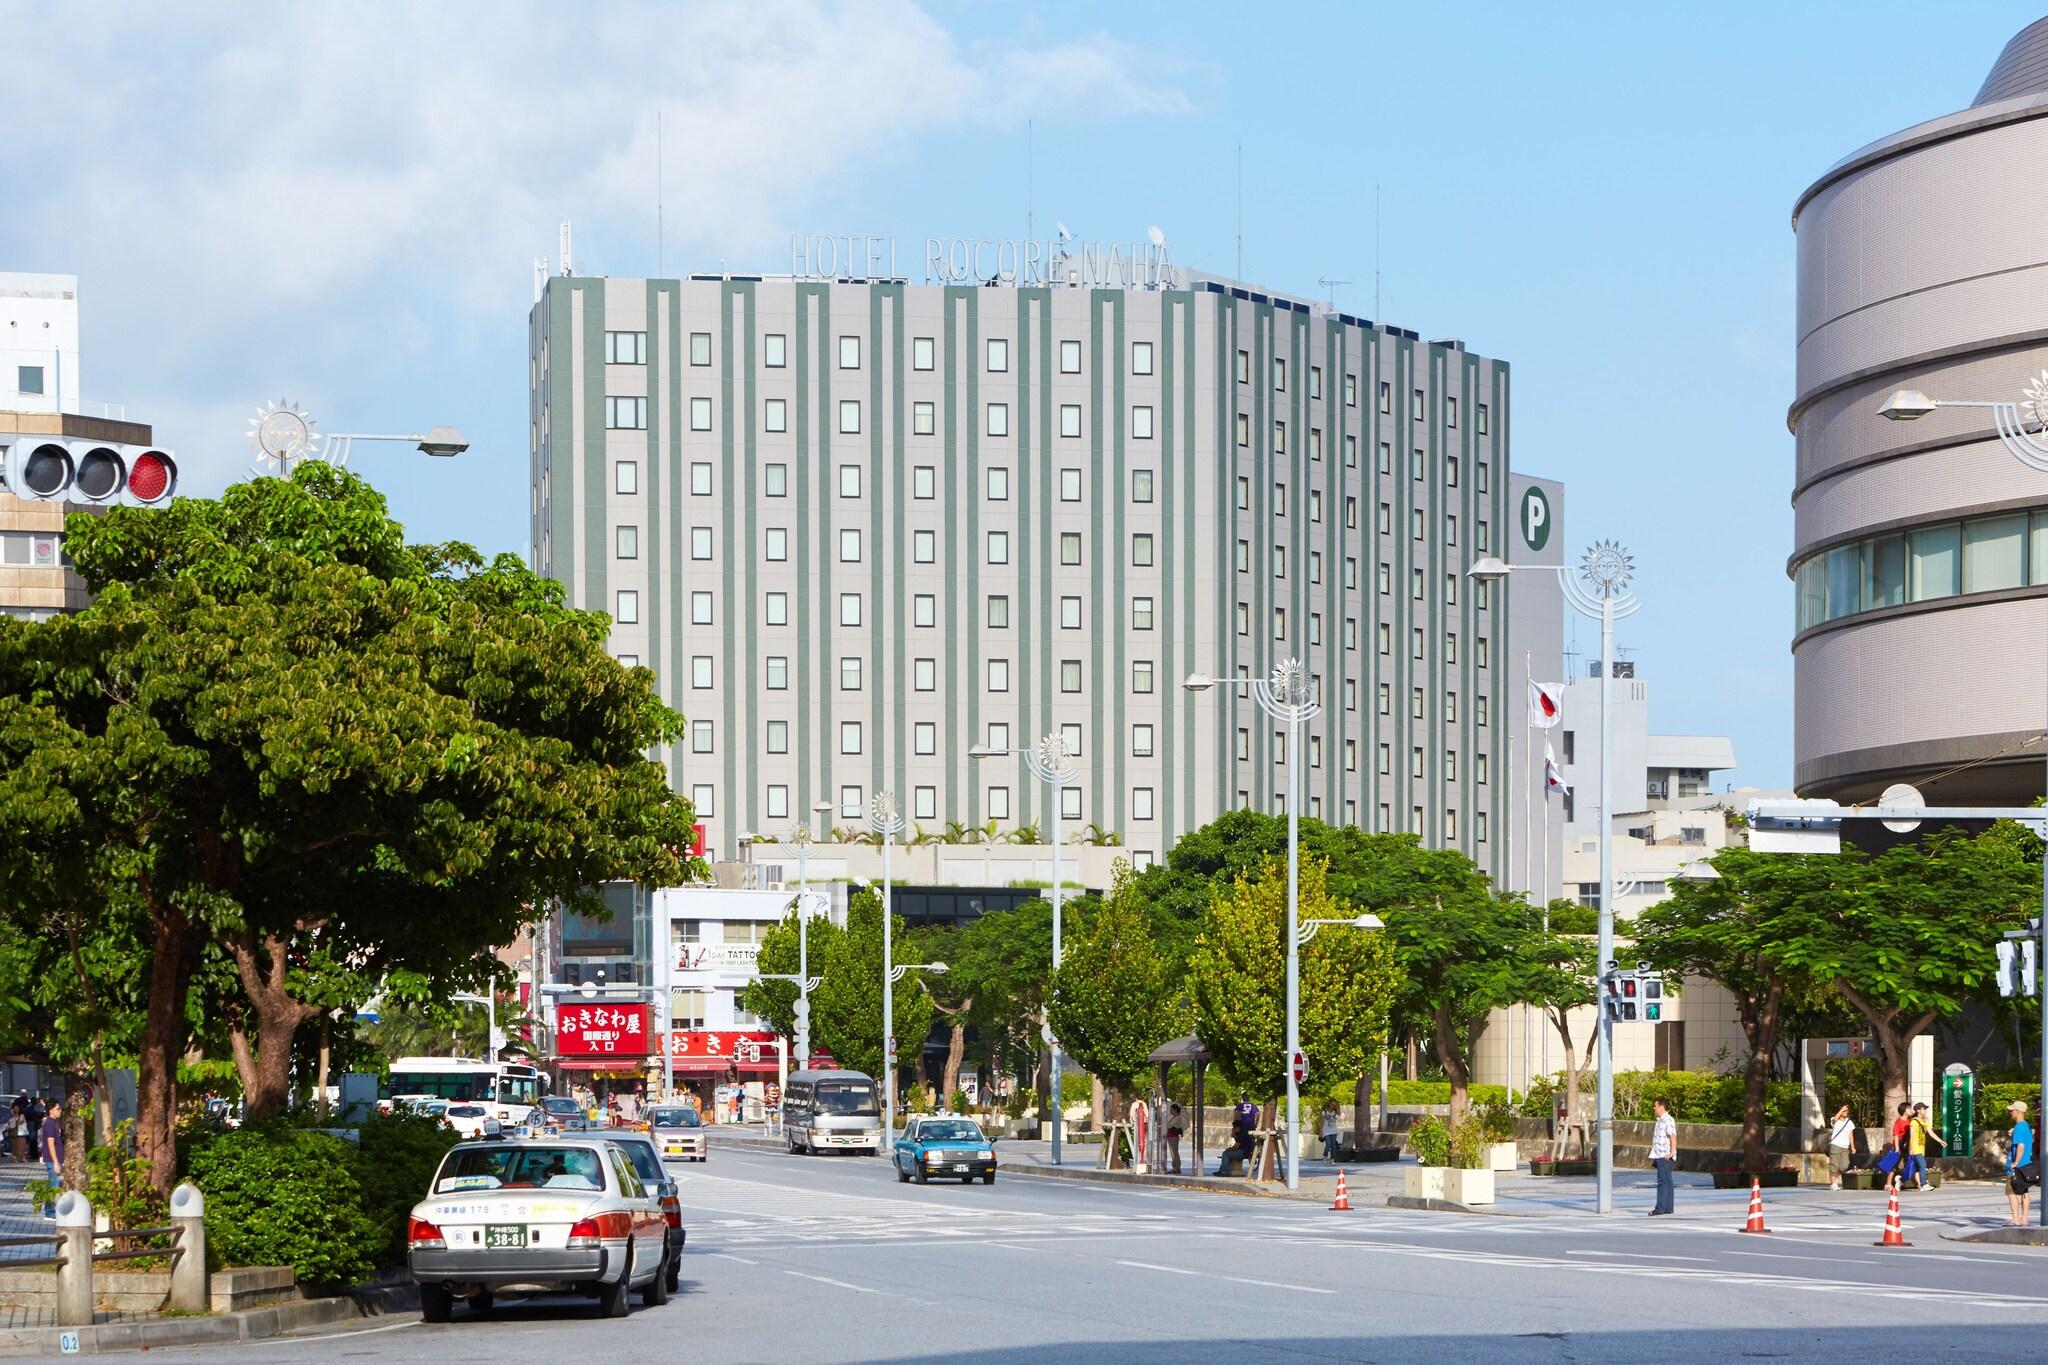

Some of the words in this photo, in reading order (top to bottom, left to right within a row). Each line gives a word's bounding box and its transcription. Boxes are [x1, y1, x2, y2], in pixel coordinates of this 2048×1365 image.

[791, 234, 906, 279] HOTEL
[925, 238, 1066, 284] ROCORE
[1082, 240, 1176, 285] NAHA
[1527, 495, 1546, 542] P
[560, 1007, 642, 1035] おきなわ屋
[588, 1040, 615, 1052] 入口
[470, 1205, 490, 1214] 178
[494, 1233, 525, 1246] 38-81
